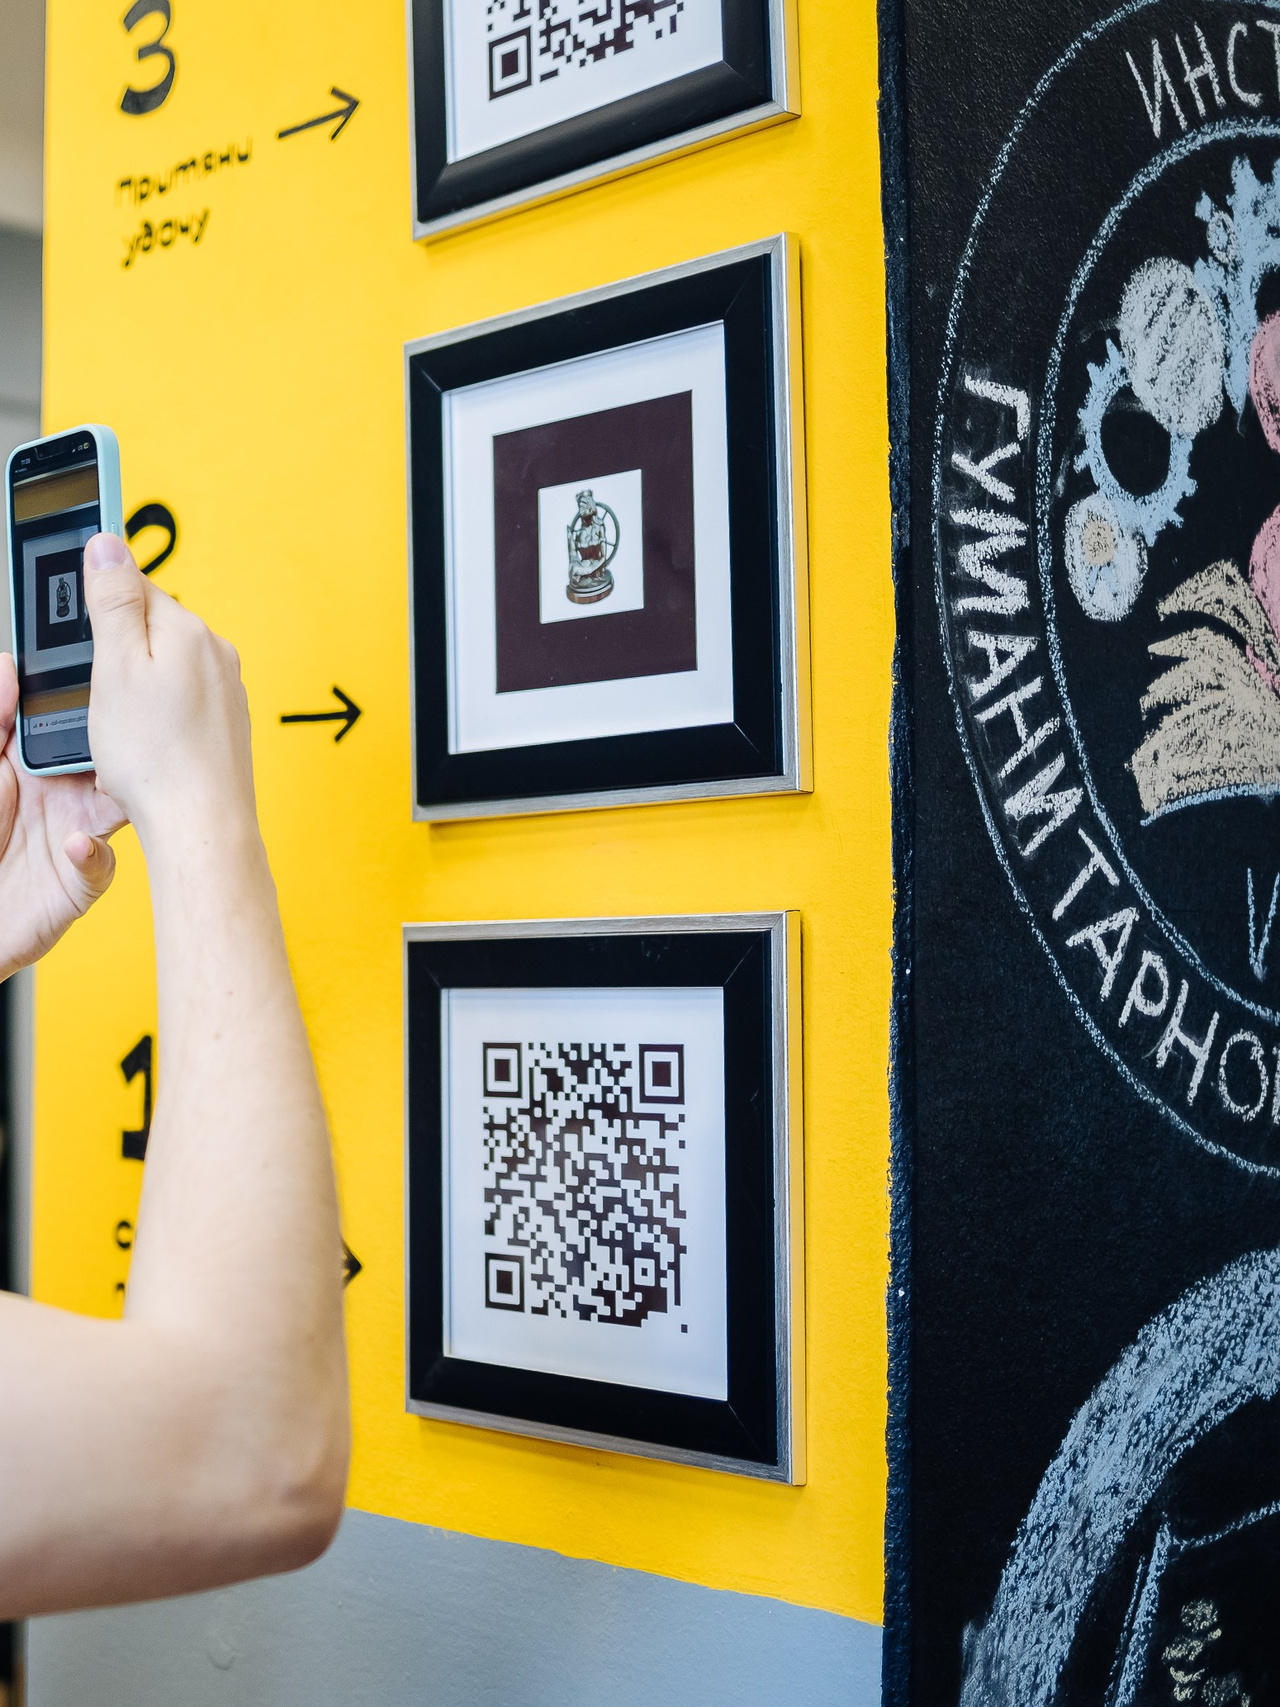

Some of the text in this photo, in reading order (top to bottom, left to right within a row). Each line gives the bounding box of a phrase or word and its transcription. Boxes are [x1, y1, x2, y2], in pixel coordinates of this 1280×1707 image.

[120, 0, 176, 116] 3
[949, 374, 1280, 1125] ГУМАНИТАРНО
[120, 1034, 152, 1162] 1
